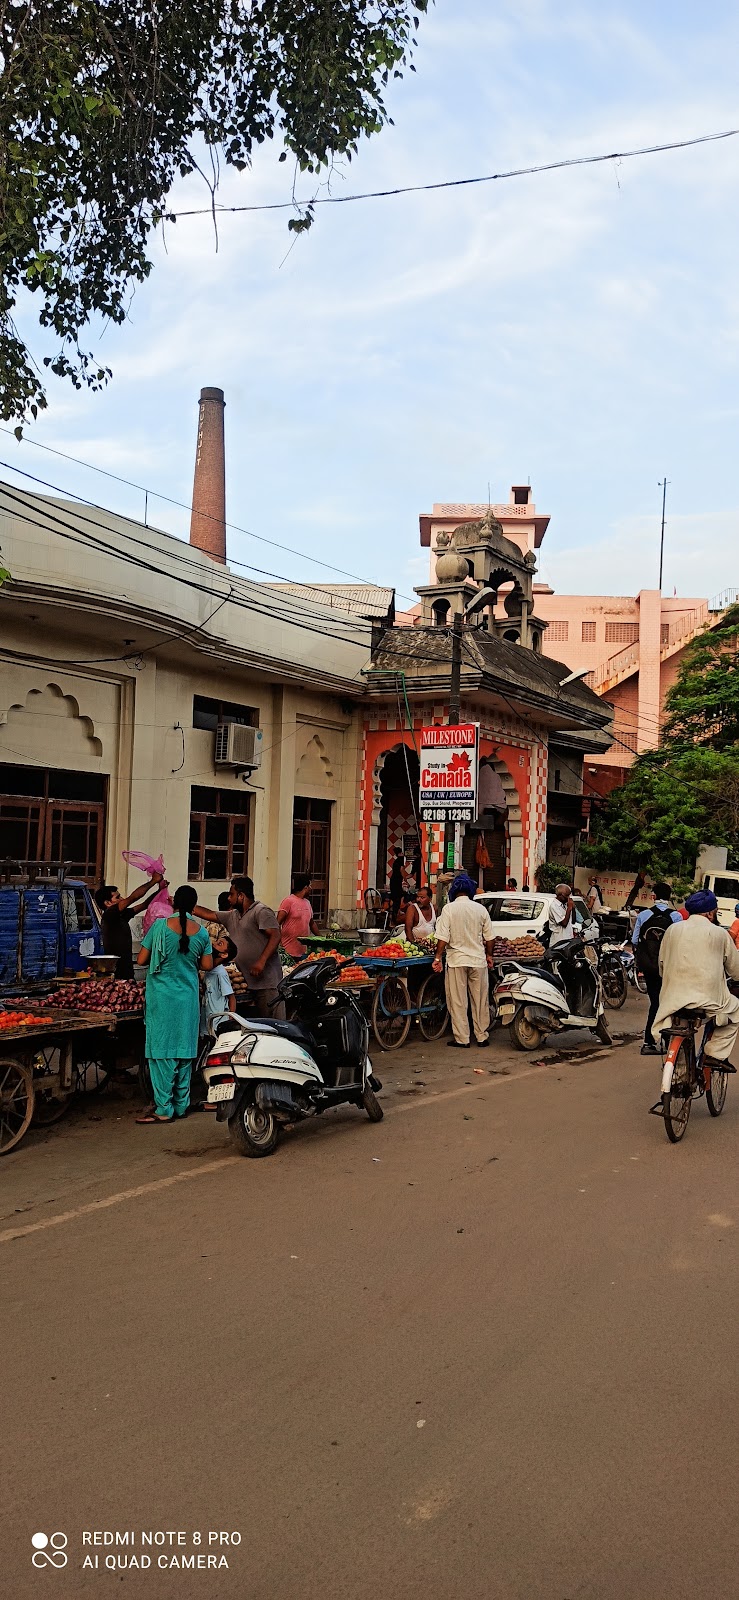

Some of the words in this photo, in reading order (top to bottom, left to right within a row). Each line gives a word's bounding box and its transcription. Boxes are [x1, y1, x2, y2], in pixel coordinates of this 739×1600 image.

[423, 729, 473, 745] MILESTONE
[422, 768, 471, 788] Canada
[423, 809, 446, 820] 92168
[448, 809, 471, 820] 12345
